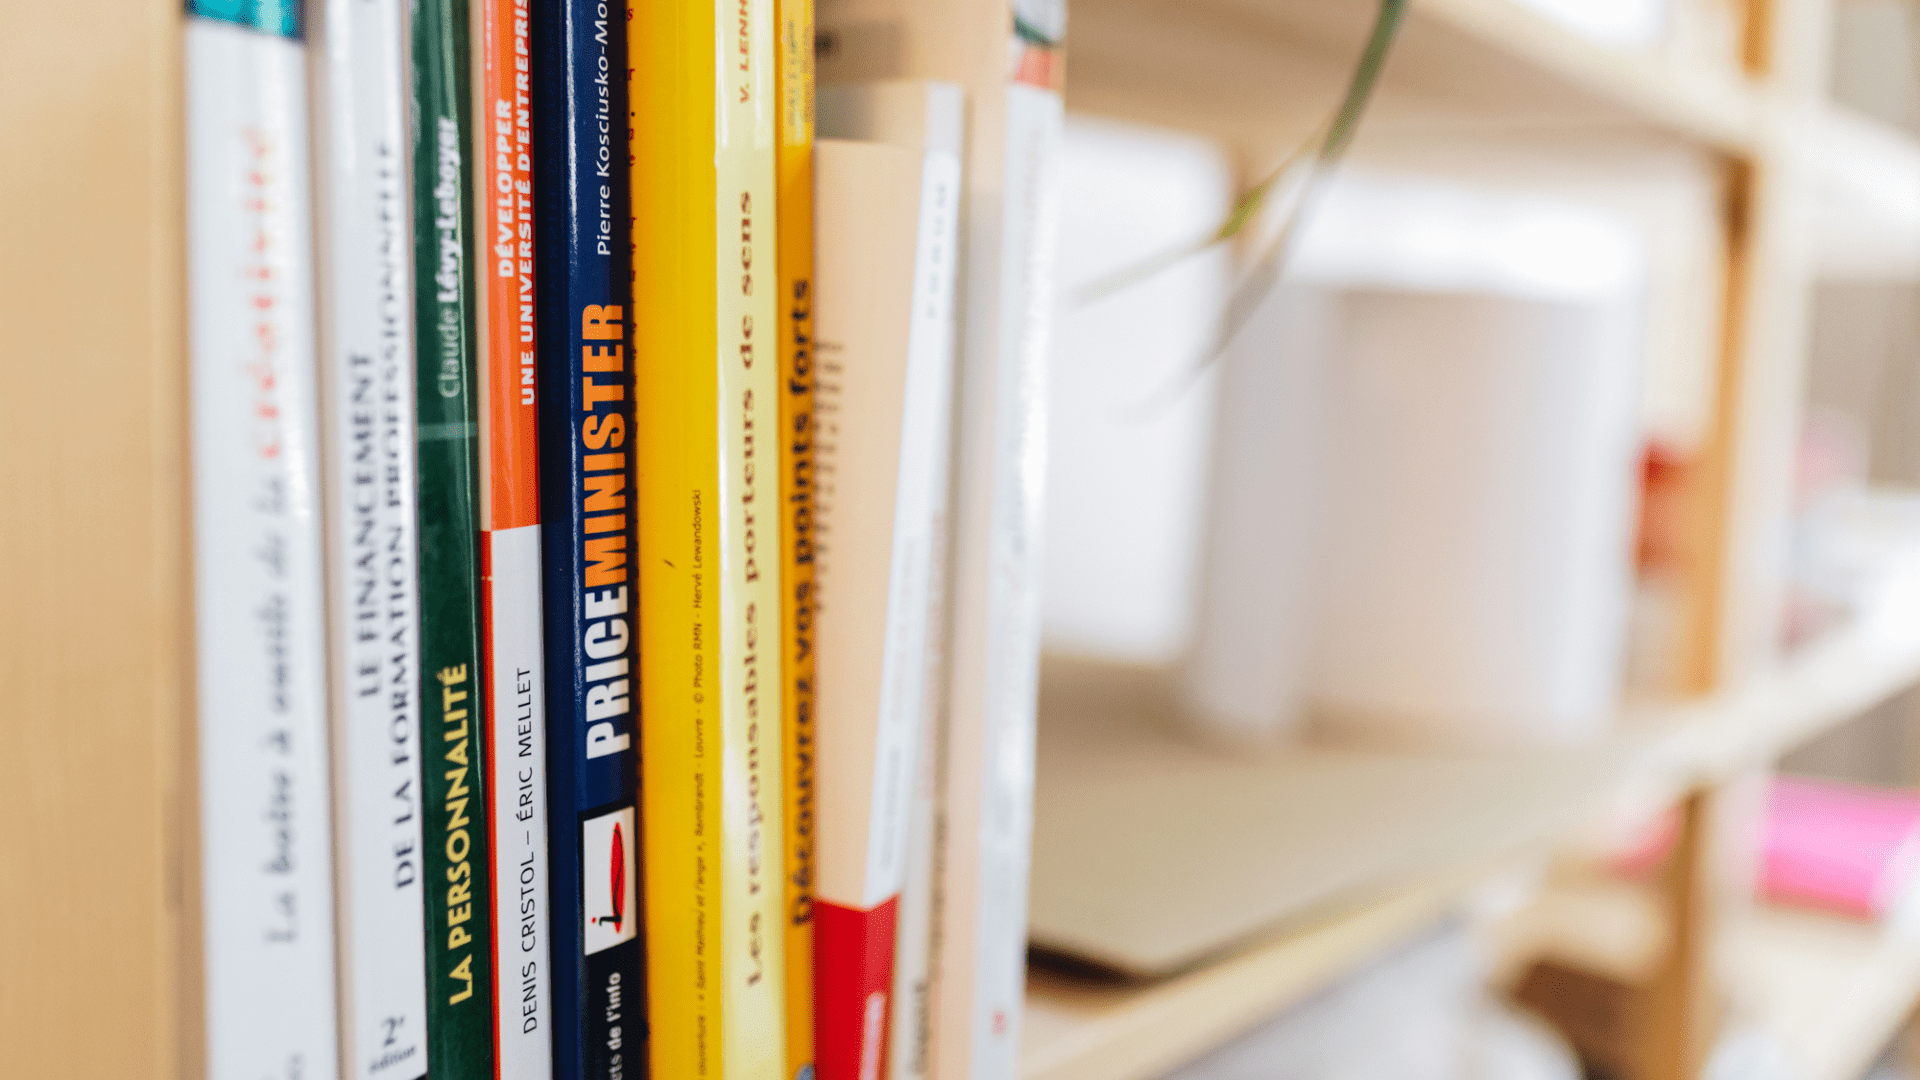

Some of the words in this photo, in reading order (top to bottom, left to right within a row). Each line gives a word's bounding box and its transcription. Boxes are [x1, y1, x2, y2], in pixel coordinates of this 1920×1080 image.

[738, 83, 750, 104] V.
[433, 115, 463, 303] Lévy-Leboyer
[493, 98, 514, 278] DÉVELOPPER
[596, 184, 611, 256] Pierre
[514, 178, 534, 343] UNIVERSITÉ
[740, 191, 753, 296] sens
[373, 142, 401, 507] PROFESSIONNELLE
[436, 306, 461, 398] Claude
[739, 315, 754, 370] de
[786, 279, 812, 396] forts
[520, 349, 535, 406] UNE
[347, 352, 380, 643] FINANCEMENT
[740, 390, 760, 583] porteurs
[786, 412, 814, 565] points
[581, 304, 631, 760] PRICEMINISTER
[691, 488, 703, 569] Lewandowski
[691, 573, 703, 609] Hervé
[793, 582, 813, 664] vos
[384, 525, 411, 766] FORMATION
[691, 623, 703, 650] RMN
[692, 654, 704, 688] Photo
[355, 663, 381, 698] LE
[516, 667, 533, 758] MELLET
[693, 718, 705, 759] Louvre
[742, 603, 764, 896] responsables
[391, 779, 414, 825] LA
[436, 665, 472, 950] PERSONNALITÉ
[515, 766, 534, 822] ÉRIC
[693, 773, 705, 837] Rembrandt
[786, 676, 814, 926] Découvrez
[393, 839, 416, 889] DE
[519, 851, 536, 953] CRISTOL
[694, 894, 706, 907] et
[449, 953, 473, 1006] LA
[694, 960, 706, 990] Saint
[745, 911, 763, 987] Les
[521, 961, 538, 1034] DENIS
[604, 971, 623, 1022] l'info
[605, 1026, 623, 1050] de
